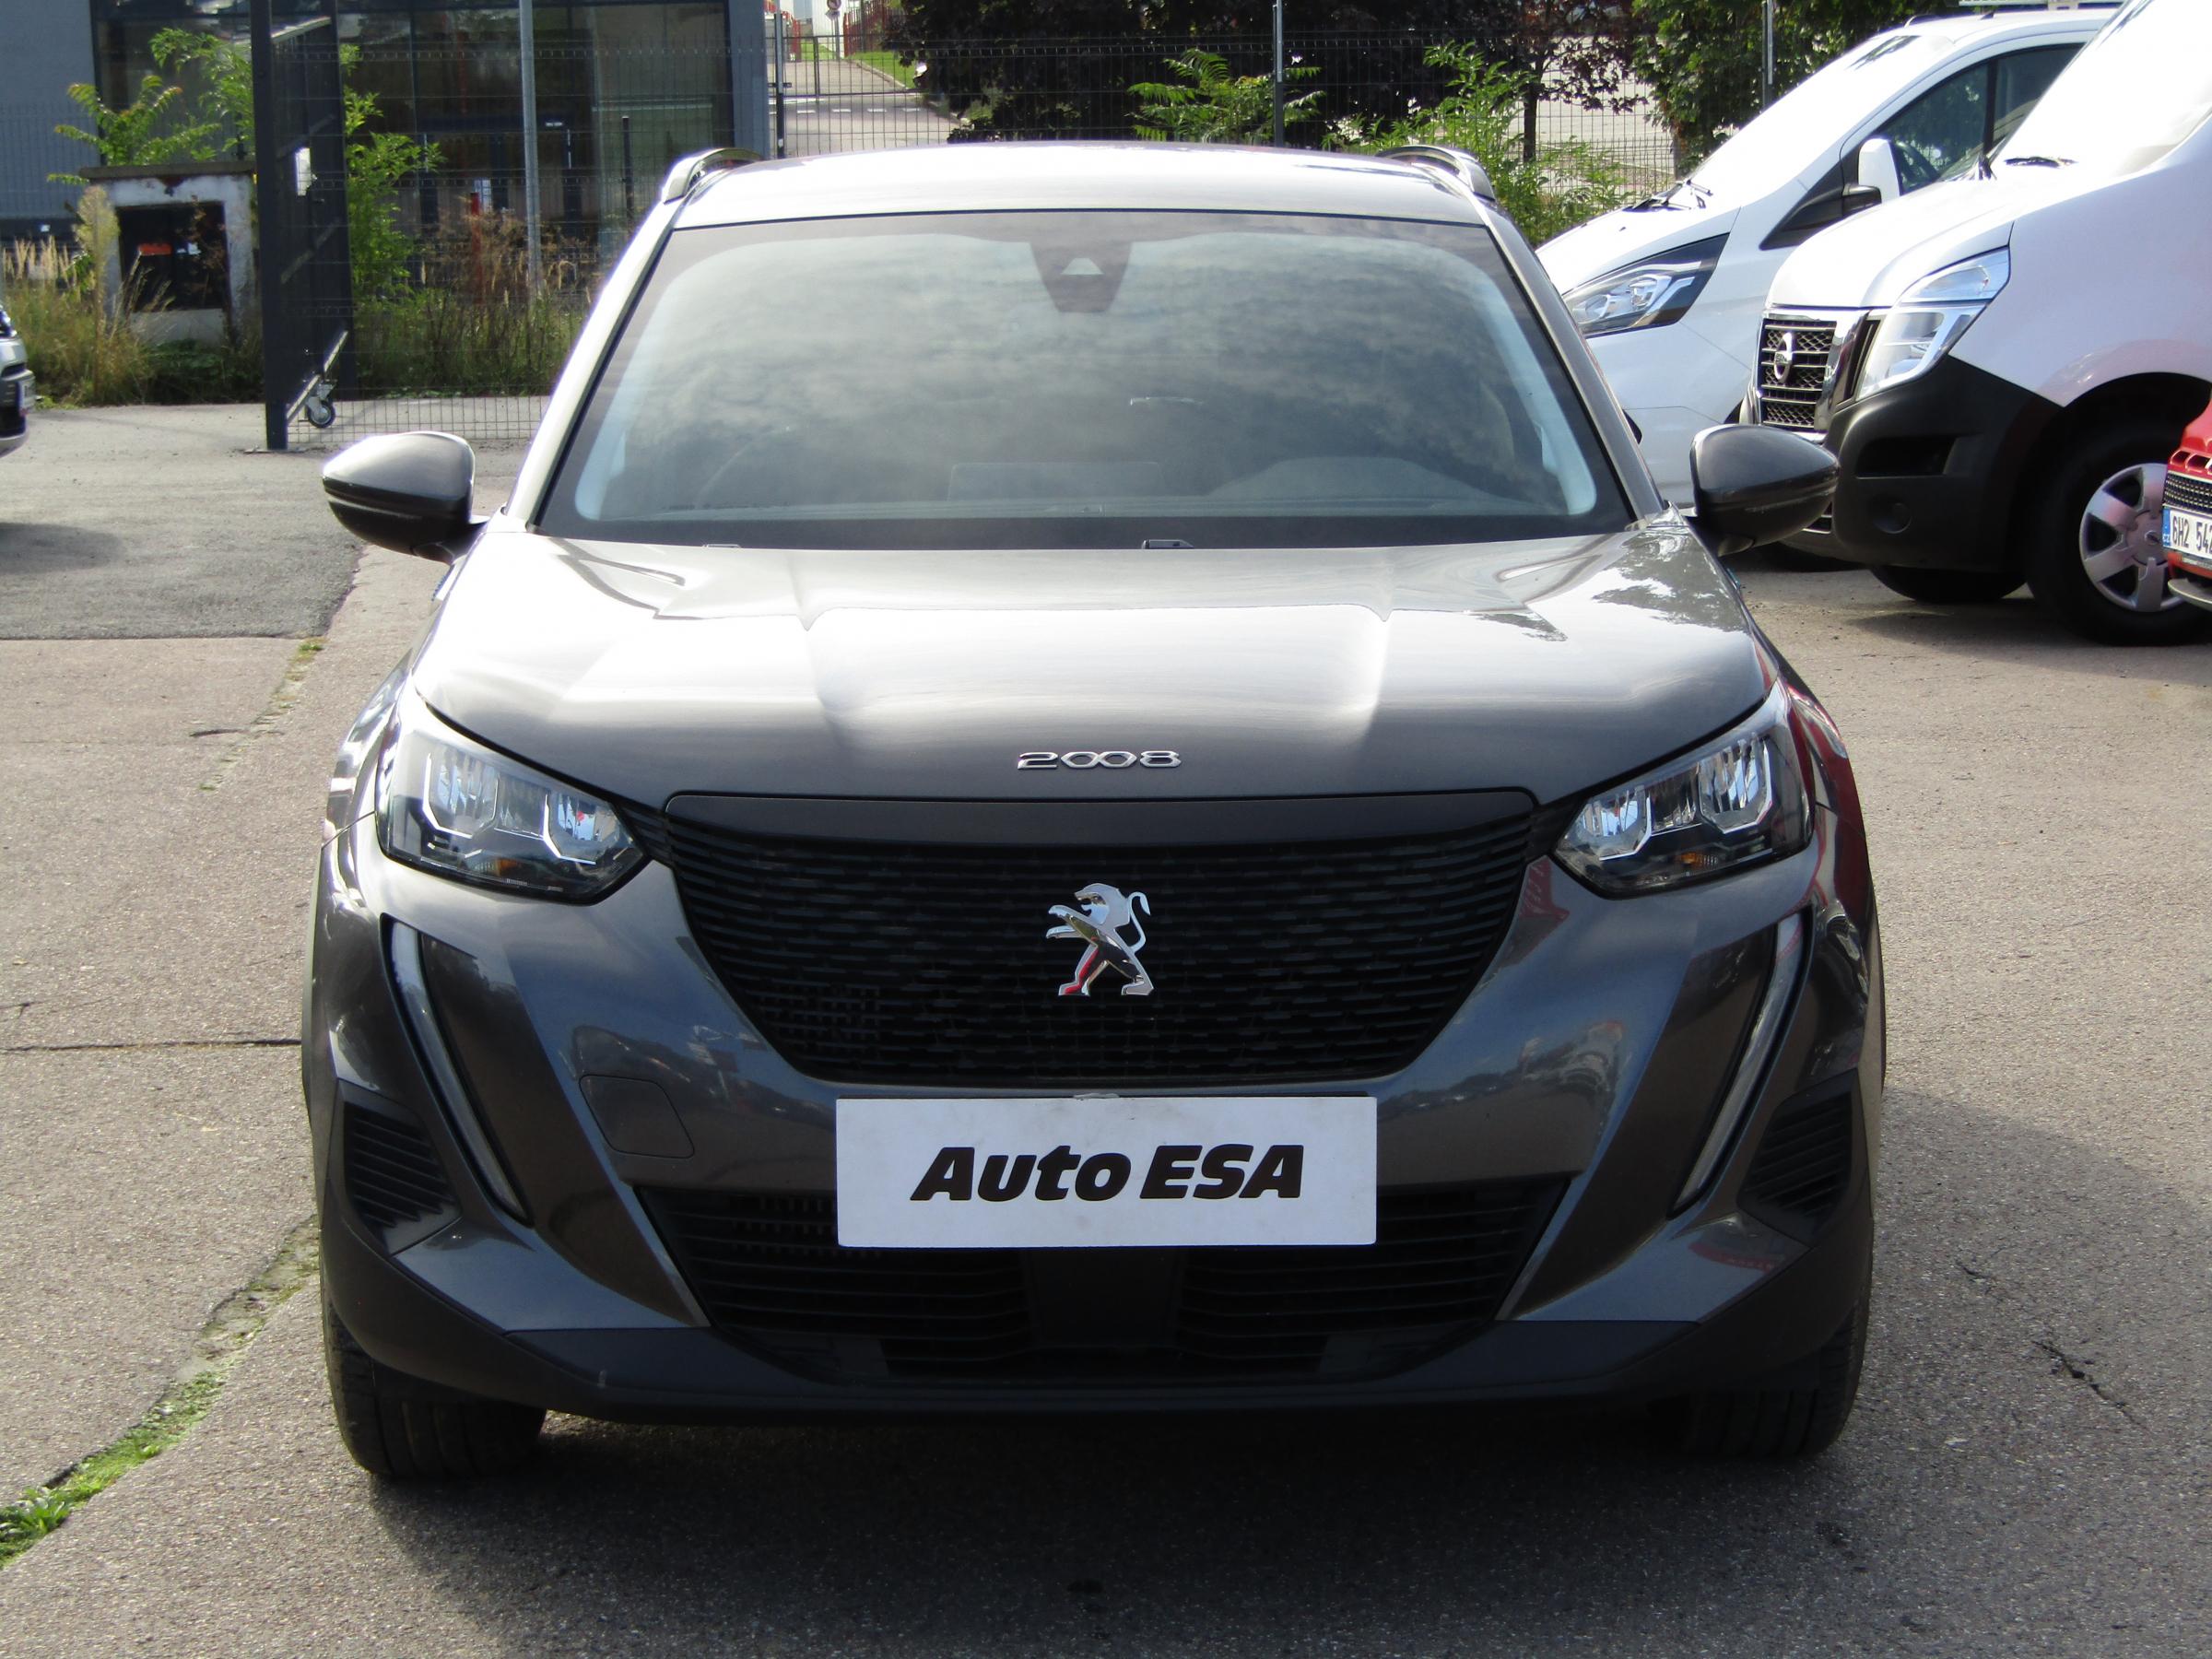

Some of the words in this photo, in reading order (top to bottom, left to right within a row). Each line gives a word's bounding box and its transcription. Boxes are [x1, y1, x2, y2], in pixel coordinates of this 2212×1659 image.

[2172, 515, 2190, 548] 6H2
[1017, 750, 1182, 771] 2008
[910, 1145, 1132, 1203] Auto
[1139, 1143, 1304, 1200] ESA
